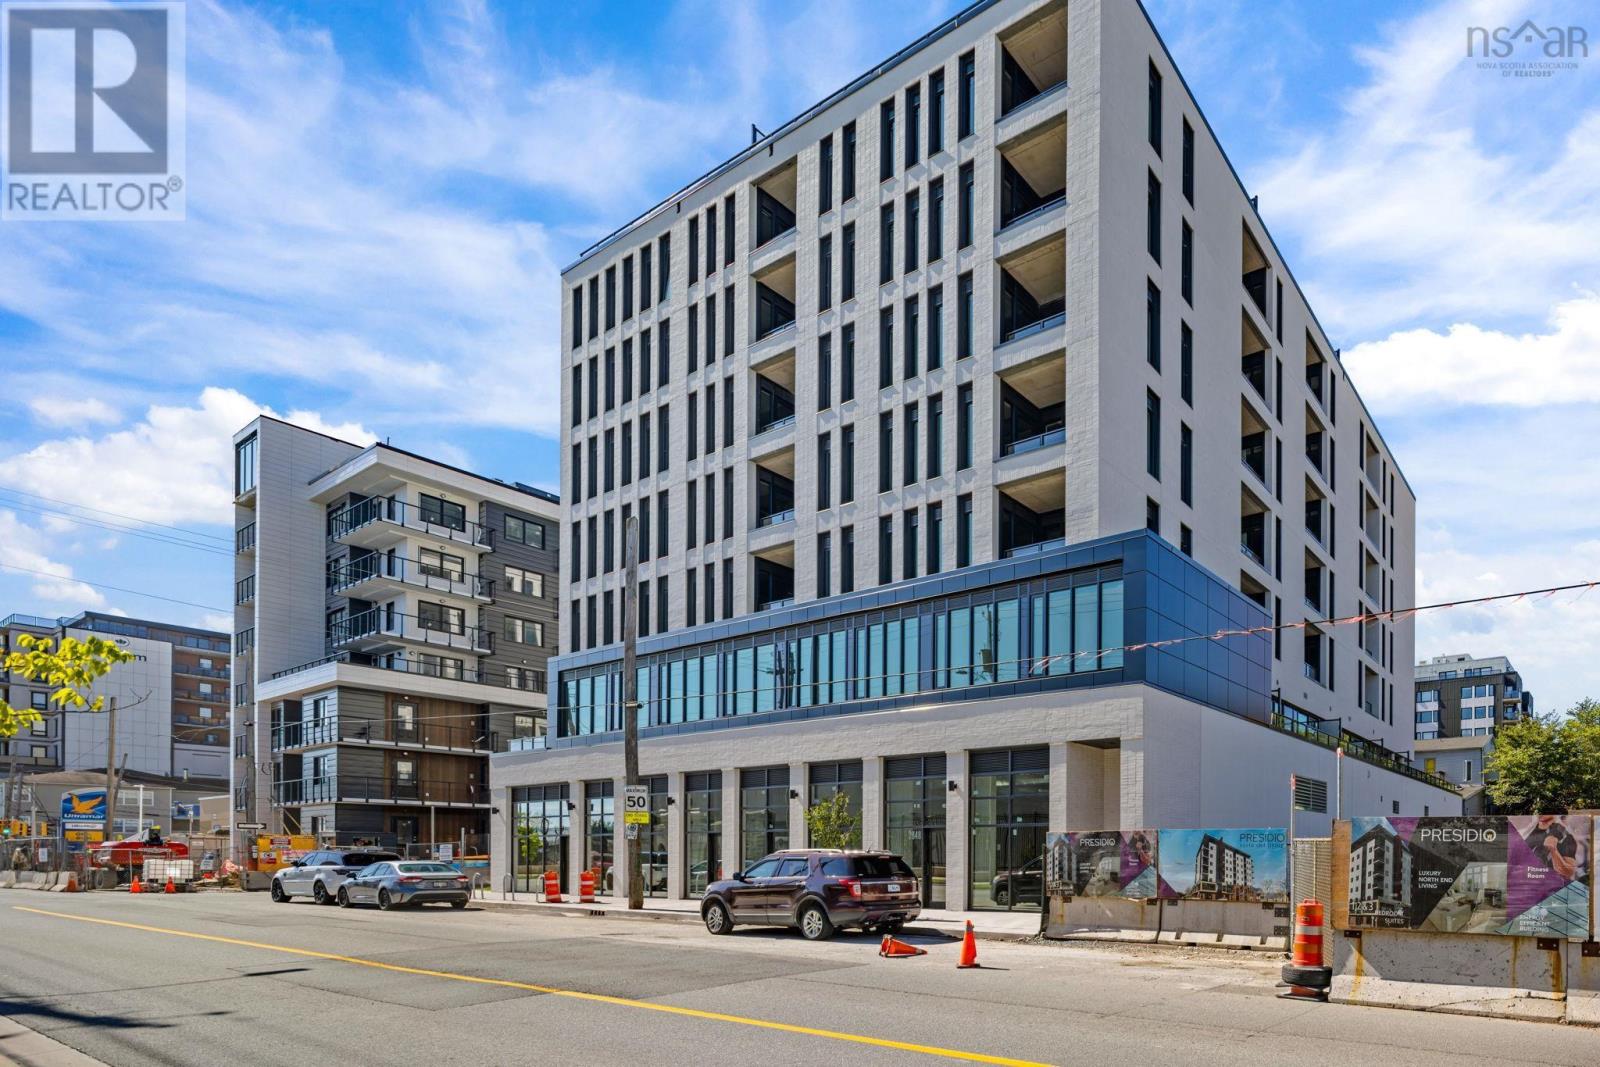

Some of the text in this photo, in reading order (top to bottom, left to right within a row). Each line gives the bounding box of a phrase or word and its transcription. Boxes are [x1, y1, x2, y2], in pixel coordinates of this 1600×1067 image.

[627, 796, 646, 808] 50
[1239, 832, 1286, 843] PRESIDIO
[1421, 828, 1497, 842] PRESIDIO
[1079, 838, 1116, 847] PRESIDIO
